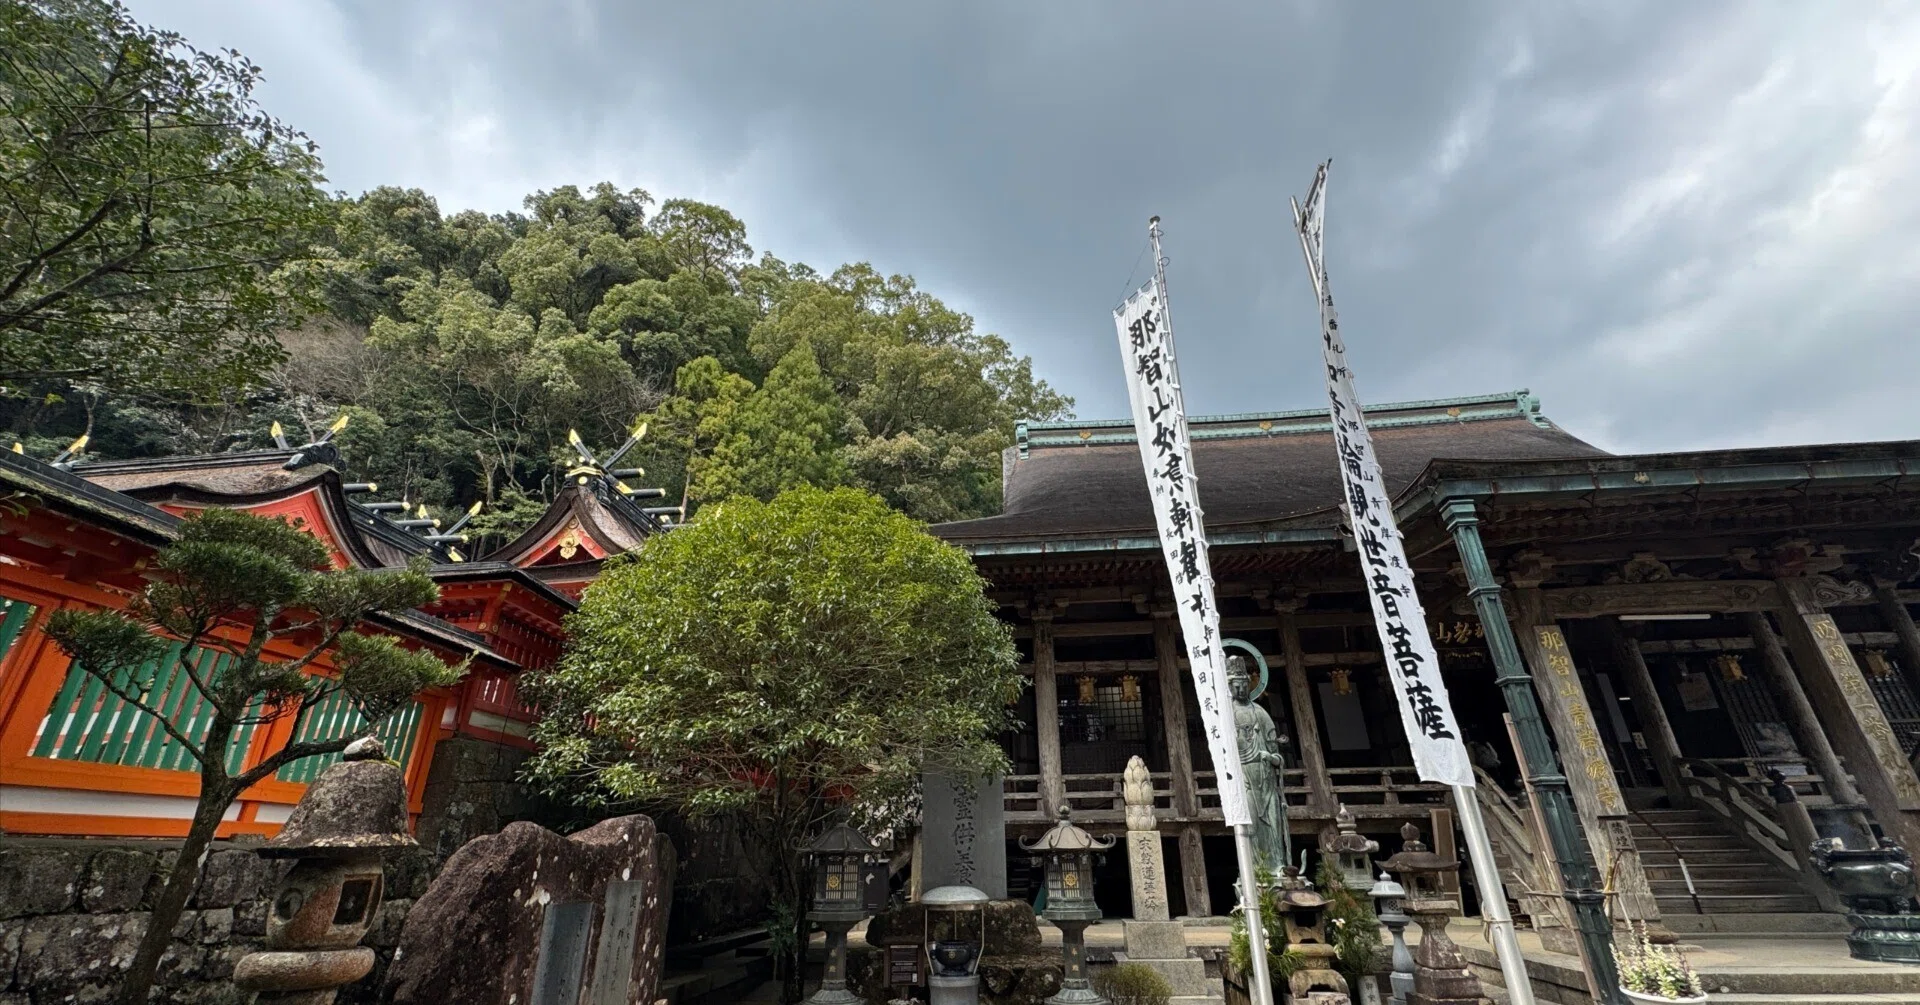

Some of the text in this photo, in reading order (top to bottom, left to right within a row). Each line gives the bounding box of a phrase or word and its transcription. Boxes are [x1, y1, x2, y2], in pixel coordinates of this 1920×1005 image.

[1540, 631, 1618, 810] 那智山青岸渡寺
[1611, 821, 1629, 847] 禁煙
